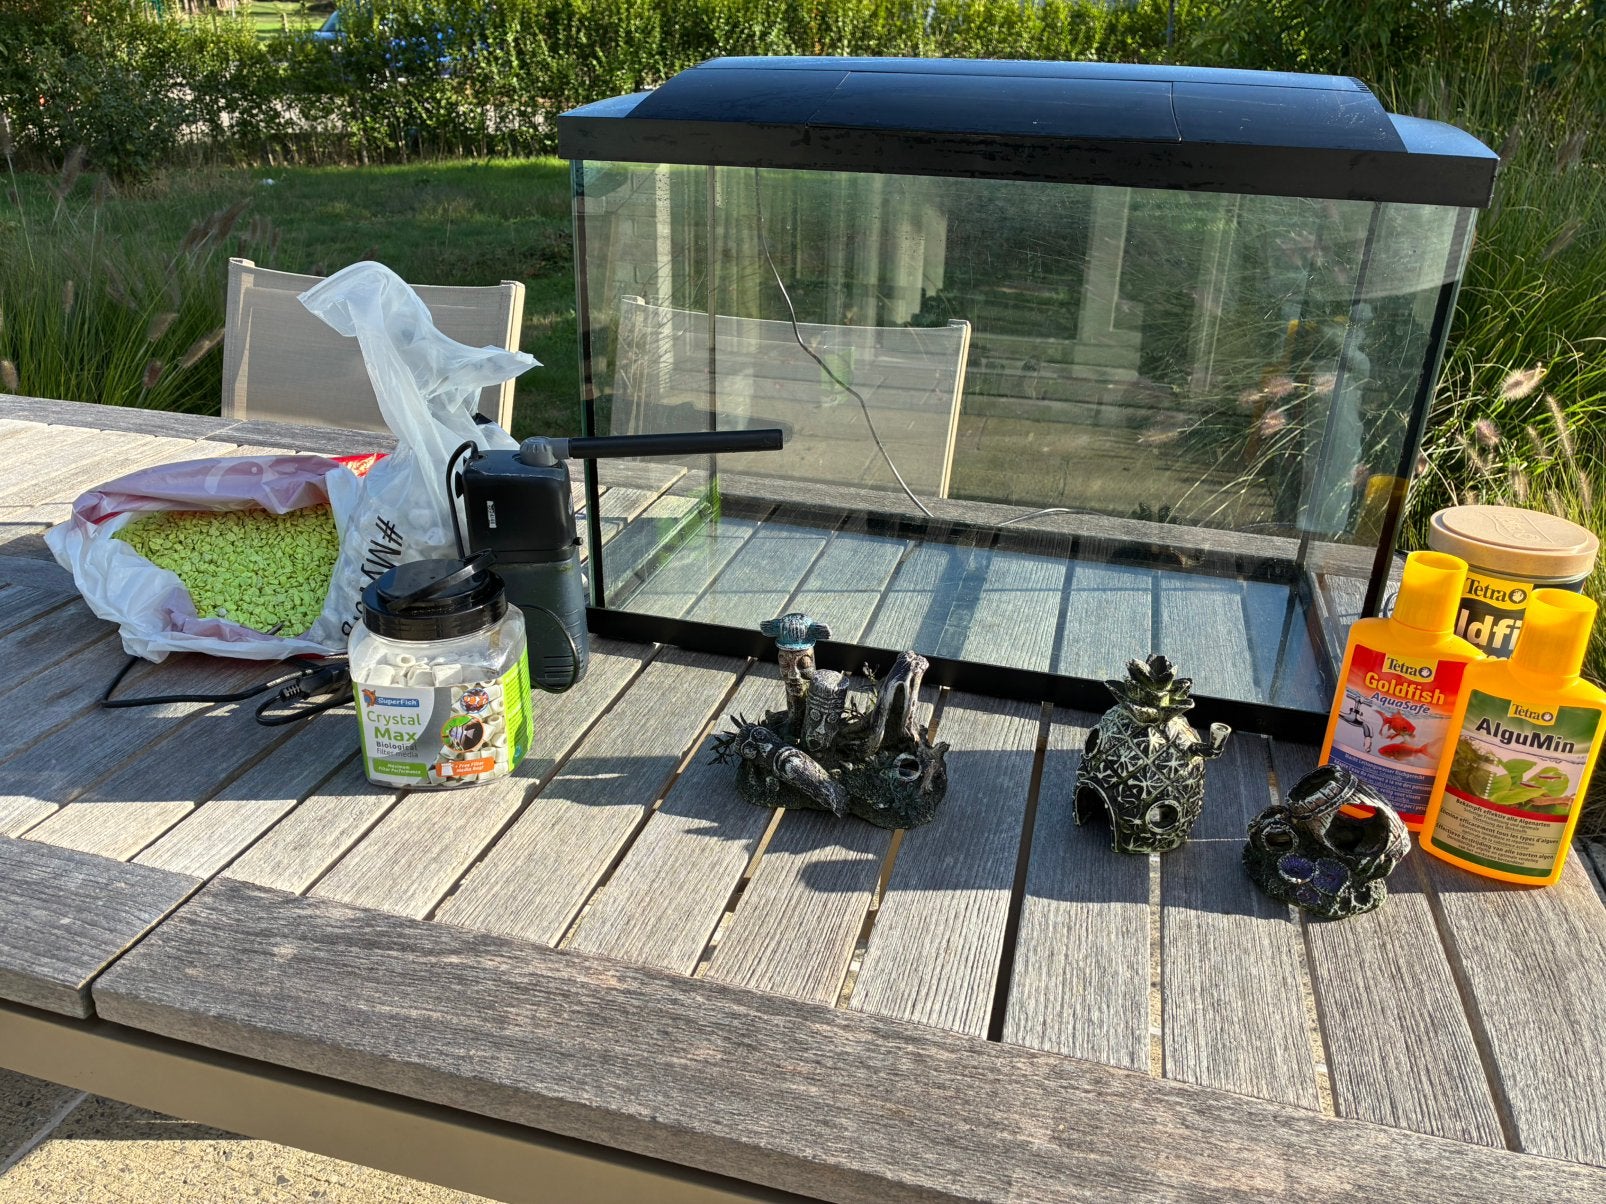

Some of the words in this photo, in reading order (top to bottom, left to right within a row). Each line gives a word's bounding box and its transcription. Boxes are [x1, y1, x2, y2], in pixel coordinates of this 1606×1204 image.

[1466, 577, 1507, 602] Tetra
[1455, 608, 1522, 650] ldfi
[1387, 657, 1417, 677] Tetra
[1365, 671, 1445, 705] Goldfish
[1371, 692, 1430, 715] AquaSafe
[1512, 703, 1541, 720] Tetra
[367, 710, 421, 726] Crystal
[374, 726, 417, 742] Max
[1475, 717, 1575, 754] AlguMin
[376, 741, 418, 751] Biological
